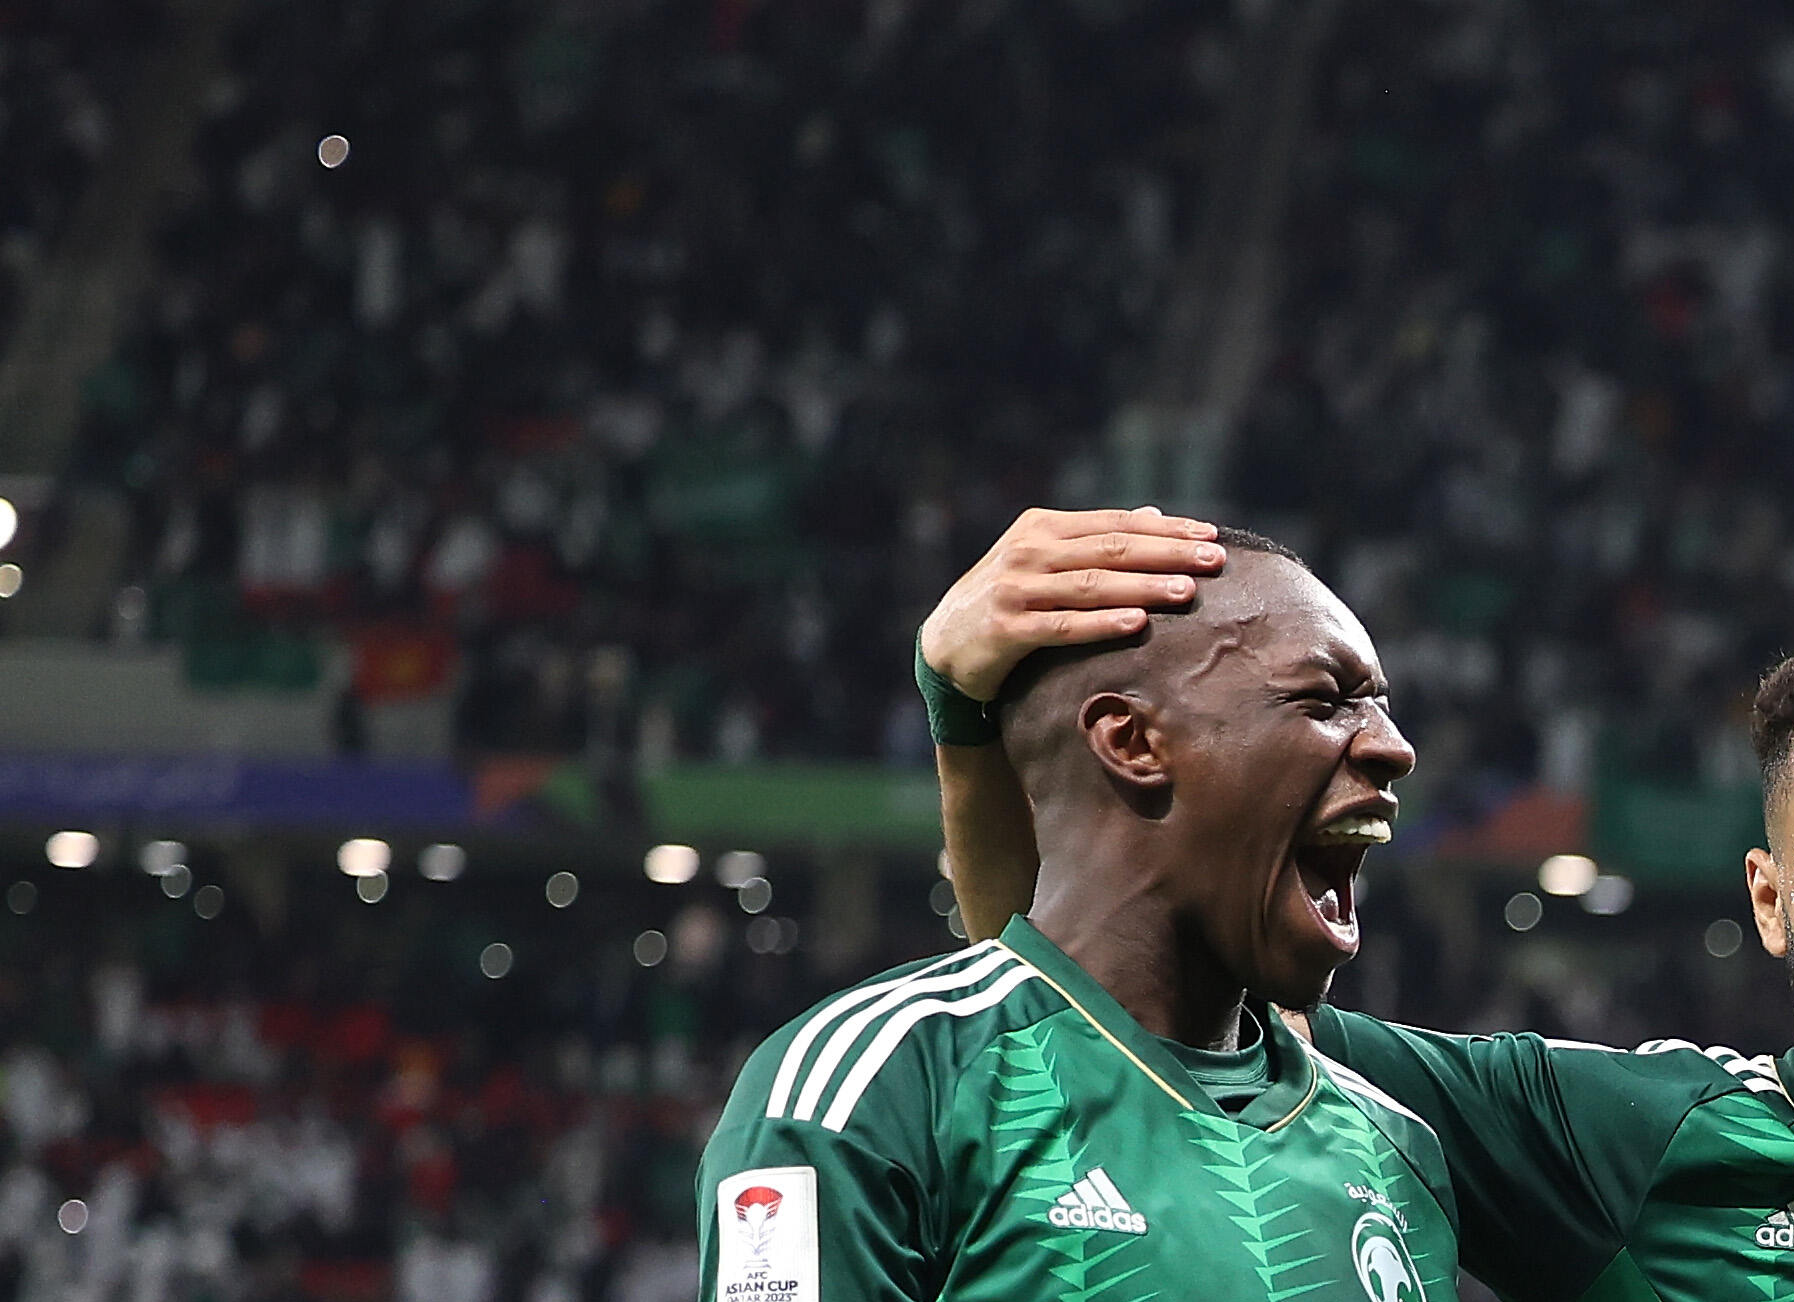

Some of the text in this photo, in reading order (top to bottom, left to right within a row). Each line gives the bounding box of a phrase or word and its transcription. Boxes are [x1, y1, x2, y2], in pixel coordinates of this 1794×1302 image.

[1048, 1203, 1148, 1235] adidas
[747, 1271, 768, 1280] AFC
[726, 1280, 799, 1296] ASIAN CUP
